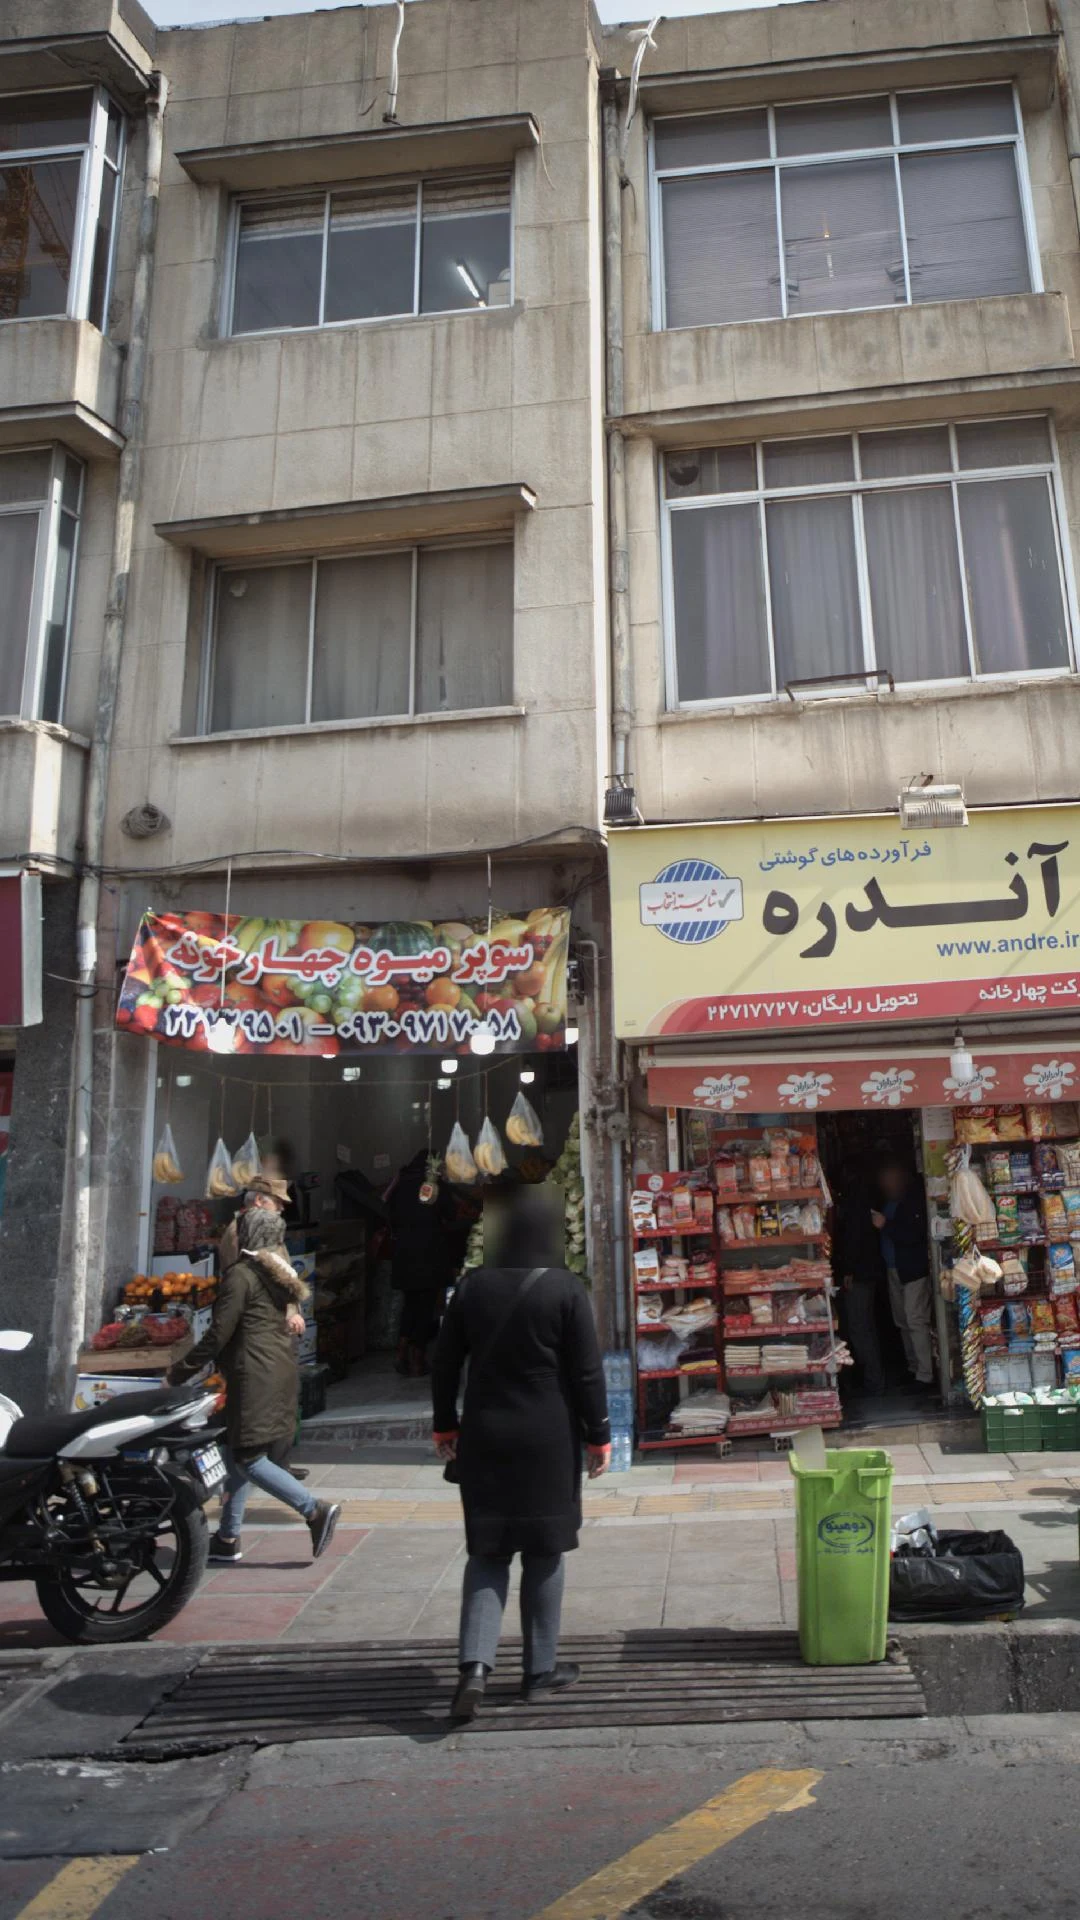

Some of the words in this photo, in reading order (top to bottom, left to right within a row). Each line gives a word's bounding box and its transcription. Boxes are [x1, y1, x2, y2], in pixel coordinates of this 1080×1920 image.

[758, 847, 819, 872] گوشتی
[936, 930, 1080, 957] www.andre.ir
[352, 948, 449, 984] میوه
[453, 941, 533, 984] سوپر
[866, 992, 919, 1014] تحویل
